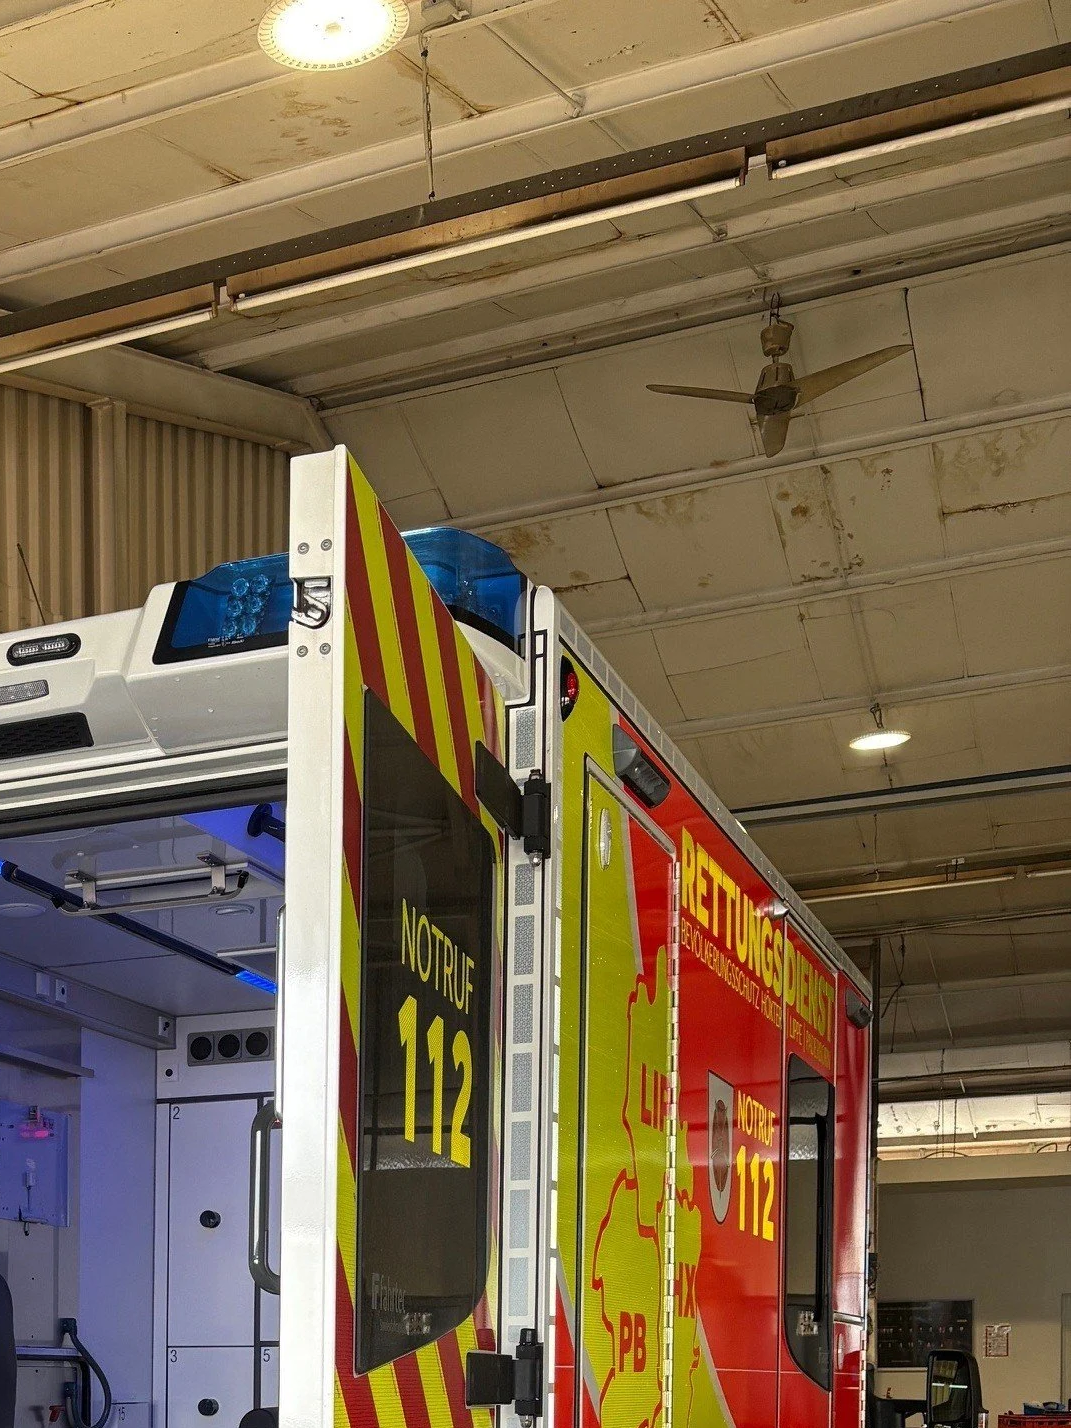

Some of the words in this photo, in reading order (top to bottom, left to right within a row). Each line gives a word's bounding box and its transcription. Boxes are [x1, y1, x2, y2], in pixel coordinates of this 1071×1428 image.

[401, 897, 475, 1014] NOTRUF
[681, 825, 835, 1042] RETTUNGSDIENST
[681, 916, 760, 1010] BEVÖLKERUNGSSCHUTZ
[172, 1106, 181, 1120] 2
[398, 994, 473, 1169] 112
[737, 1089, 776, 1147] NOTRUF
[736, 1144, 775, 1242] 112
[170, 1349, 178, 1363] 3
[262, 1348, 271, 1363] 5
[619, 1311, 647, 1374] PB
